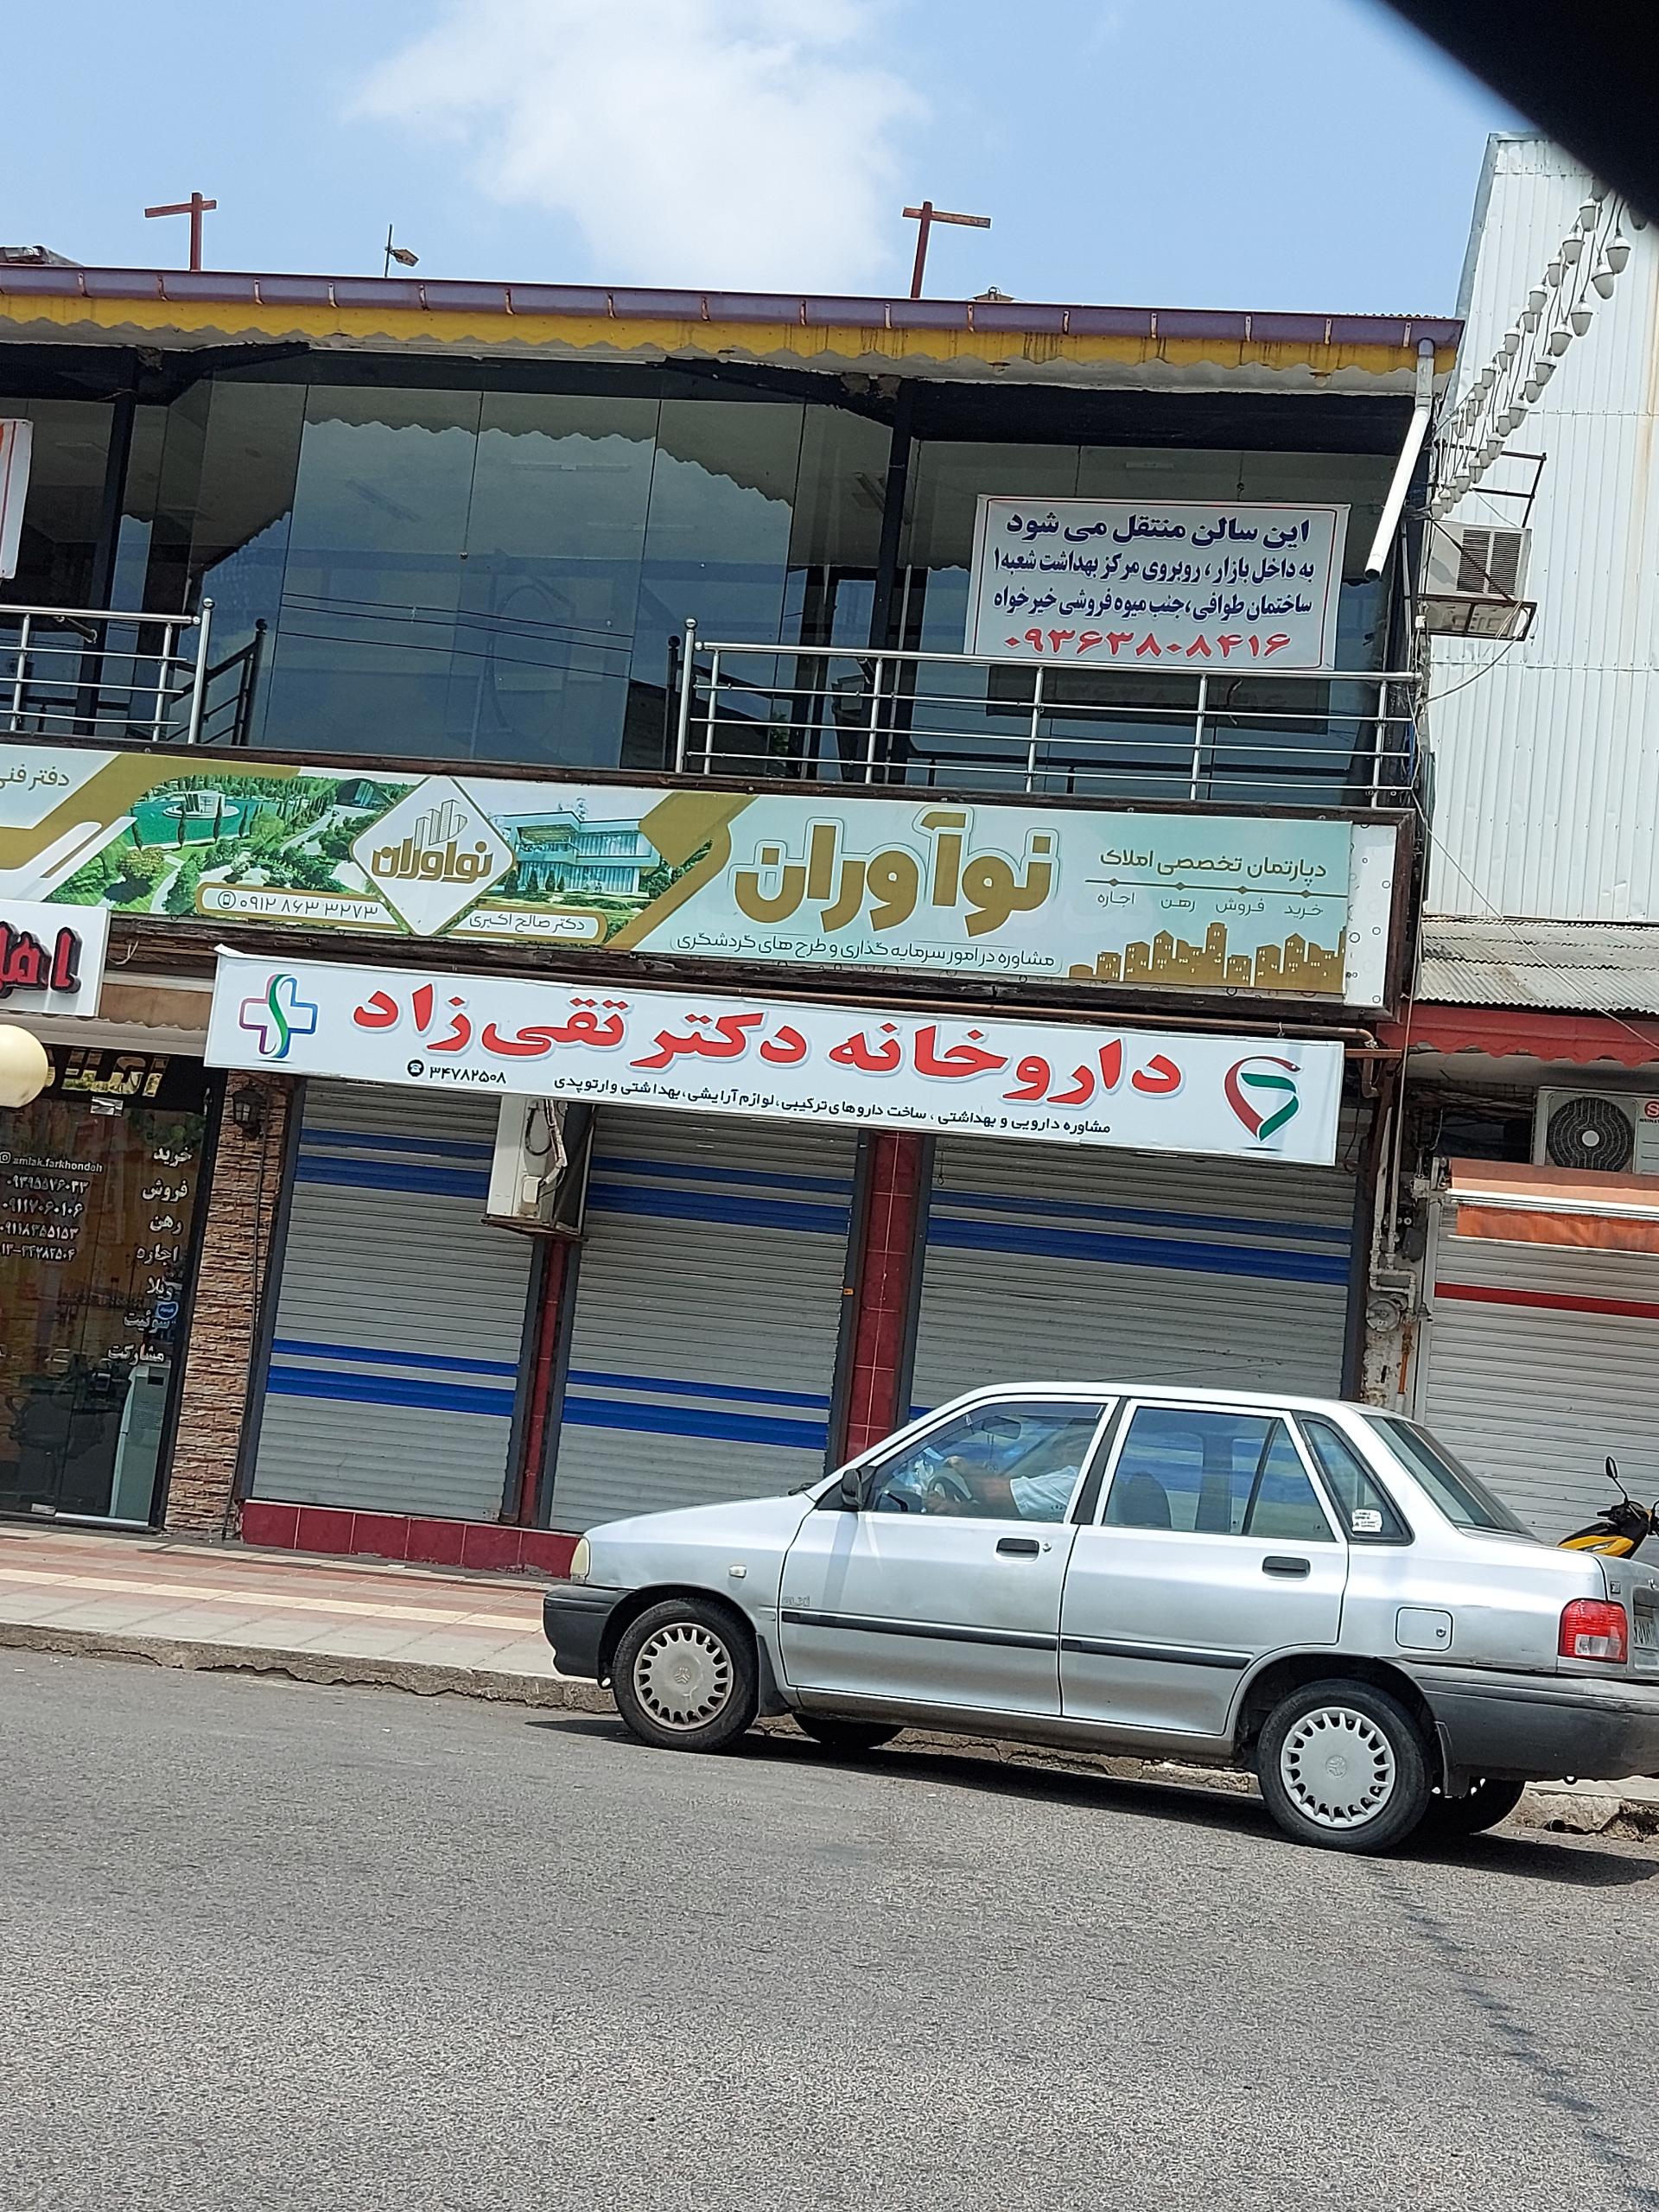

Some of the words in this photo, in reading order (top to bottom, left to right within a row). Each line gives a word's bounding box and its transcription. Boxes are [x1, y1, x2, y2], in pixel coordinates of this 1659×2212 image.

[1007, 512, 1059, 541] شود
[1064, 523, 1108, 543] می
[1112, 514, 1187, 543] منتقل
[1191, 517, 1258, 546] سالن
[1263, 519, 1310, 548] این
[1039, 550, 1098, 578] بهداشت
[1101, 552, 1139, 581] مرکز
[1142, 560, 1201, 583] روبروی
[1252, 557, 1295, 584] داخل
[1299, 562, 1314, 583] به
[1247, 594, 1312, 621] ساختمان
[1005, 627, 1292, 658] ۰۹۳۶۳۸۰۸۴۱۶
[28, 766, 69, 791] دفتر
[1100, 849, 1154, 868] املاک
[1157, 855, 1243, 875] تخصصی
[734, 810, 1054, 938] نوآوران
[1247, 856, 1327, 887] دپارتمان
[240, 896, 276, 911] ۰۹۱۲
[281, 899, 319, 914] ۸۶۳
[325, 902, 378, 919] ۳۲۷۳
[1097, 891, 1135, 907] اجاره
[1160, 898, 1196, 912] رهن
[1216, 897, 1265, 916] فروش
[469, 913, 512, 929] اکبری
[1284, 903, 1324, 919] خرید
[514, 914, 550, 932] صالح
[551, 918, 585, 933] دکتر
[677, 932, 756, 952] گردشگری
[758, 935, 793, 953] های
[795, 938, 827, 957] طرح
[949, 946, 978, 965] امور
[978, 951, 995, 967] در
[998, 950, 1055, 969] مشاوره
[353, 982, 474, 1052] زاد
[481, 996, 629, 1057] تقی
[629, 1012, 807, 1070] دکتر
[828, 1021, 1182, 1104] داروخانه
[429, 1065, 507, 1085] ۳۴۷۸۲۵۰۸
[620, 1080, 681, 1099] بهداشتی
[887, 1106, 926, 1120] ساخت
[938, 1111, 996, 1128] بهداشتی
[1000, 1117, 1007, 1128] و
[1011, 1117, 1060, 1131] دارویی
[1063, 1120, 1111, 1135] مشاوره
[153, 1147, 193, 1166] خرید
[142, 1179, 188, 1202] فروش
[149, 1215, 182, 1234] رهن
[137, 1243, 179, 1264] اجاره
[146, 1276, 173, 1301] ویلا
[107, 1342, 165, 1366] مشارکت
